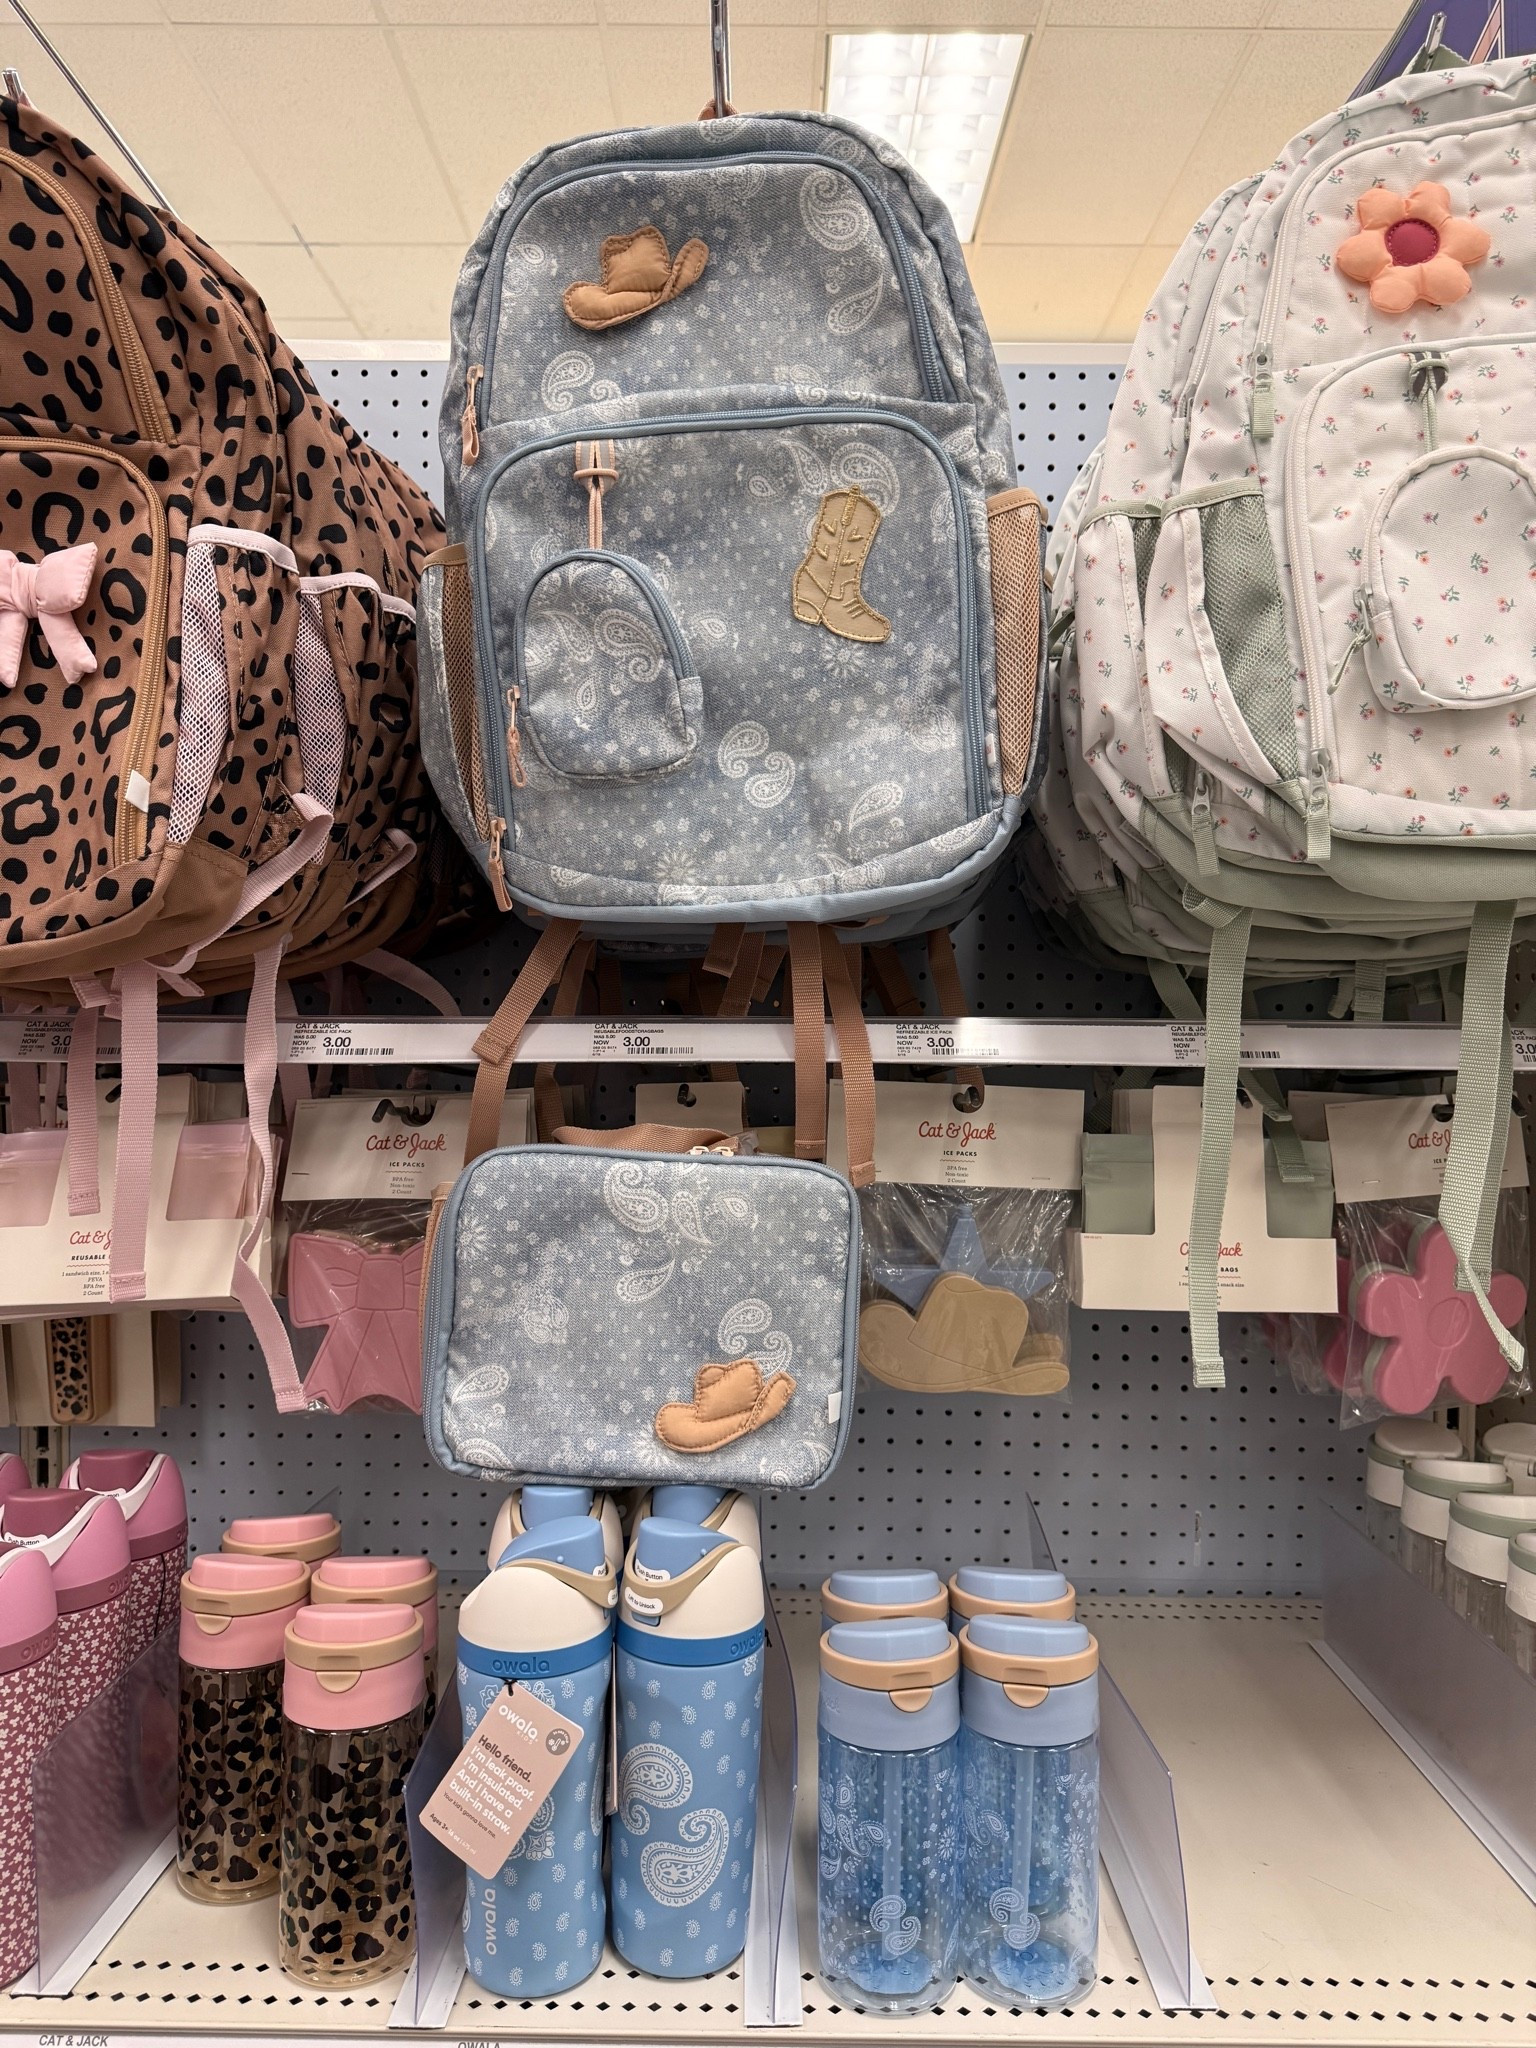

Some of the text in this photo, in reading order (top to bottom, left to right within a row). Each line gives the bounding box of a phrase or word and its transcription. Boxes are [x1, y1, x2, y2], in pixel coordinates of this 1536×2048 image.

[51, 1035, 72, 1046] 3.0
[322, 1037, 351, 1047] 3.00
[623, 1036, 650, 1047] 3.00
[926, 1037, 954, 1047] 3.00
[918, 1121, 996, 1147] Cat & Jack
[1408, 1133, 1431, 1149] Cat
[1432, 1132, 1443, 1146] &
[366, 1133, 447, 1159] Cat & Jack
[69, 1231, 91, 1245] Cat
[92, 1231, 106, 1243] &
[108, 1574, 131, 1595] owa
[646, 1572, 663, 1580] Button
[638, 1601, 656, 1609] Unlock
[730, 1630, 762, 1657] owala
[492, 1656, 550, 1674] owala
[498, 1704, 539, 1739] owala
[517, 1731, 534, 1745] KIDS
[478, 1734, 532, 1783] Hello friend.
[463, 1757, 523, 1810] I'm insulated.
[471, 1746, 535, 1801] I'm leak proof.
[456, 1769, 513, 1819] And I have a
[443, 1791, 496, 1839] Your kid's gonna love me.
[449, 1778, 511, 1835] built-in straw.
[430, 1813, 442, 1826] Ages
[442, 1822, 448, 1830] 3+
[448, 1829, 454, 1837] 16
[481, 1888, 497, 1955] owala
[39, 2034, 109, 2047] CAT & JACK
